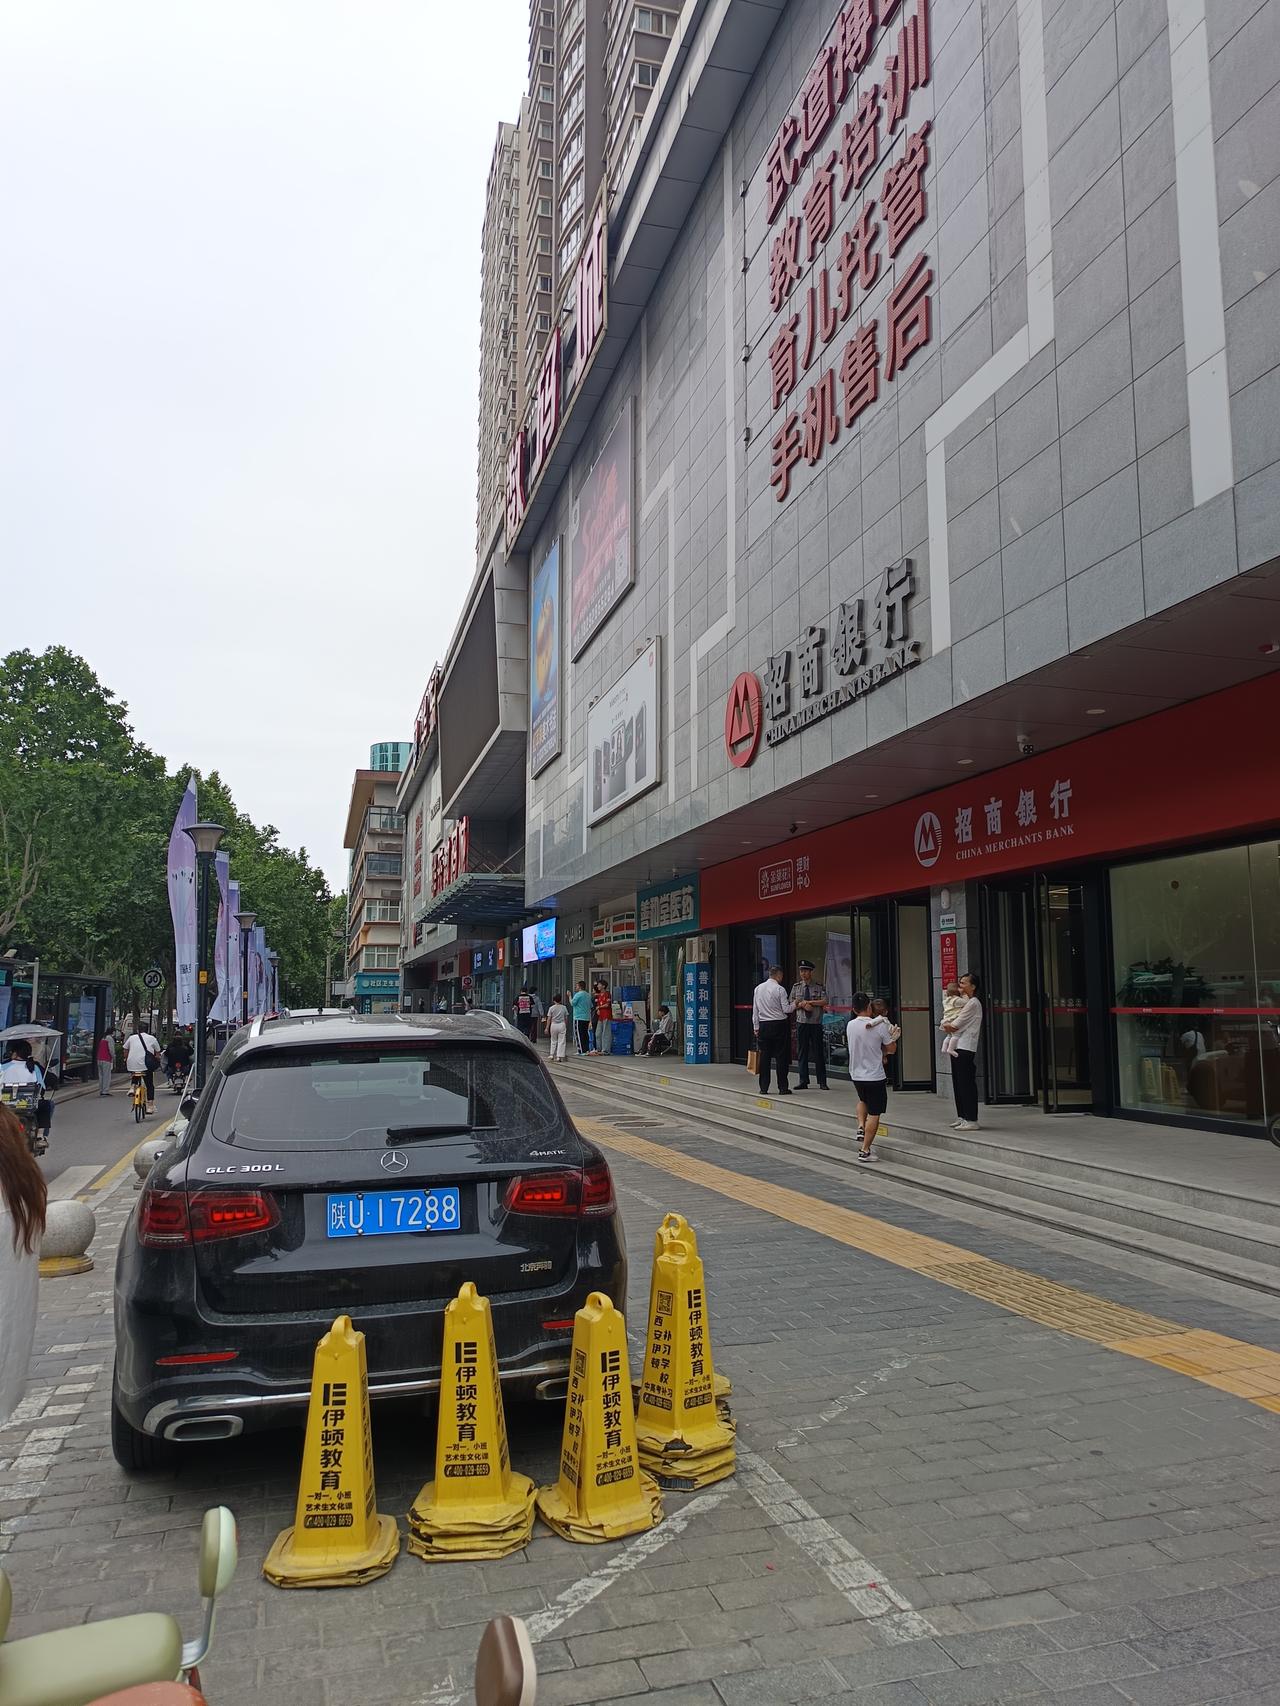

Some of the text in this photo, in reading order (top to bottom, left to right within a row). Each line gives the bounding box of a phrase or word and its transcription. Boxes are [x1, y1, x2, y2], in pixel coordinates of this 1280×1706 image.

[766, 0, 905, 225] 武道搏
[769, 0, 931, 313] 教育培训
[769, 120, 932, 411] 育儿托管
[770, 252, 933, 503] 手机售后
[764, 641, 922, 748] CHINA MERCHANTS BANK
[955, 824, 1075, 861] CHINA MERCHANTS BANK
[640, 885, 694, 931] 善和堂医药
[796, 873, 811, 890] 中心
[147, 974, 158, 983] 30
[686, 972, 694, 1056] 善和堂医药
[698, 971, 709, 1056] 善和堂医药
[205, 1163, 285, 1175] GLC 300 L
[529, 1149, 568, 1157] 4MATIC
[650, 1316, 664, 1370] 西安伊顿
[659, 1330, 673, 1385] 补习学校
[688, 1309, 704, 1377] 伊顿教育
[455, 1366, 477, 1442] 伊顿教育
[601, 1374, 622, 1449] 伊顿教育
[644, 1381, 673, 1398] 中高考补习
[319, 1409, 346, 1491] 伊顿教育
[444, 1453, 489, 1462] 艺术生文化课
[596, 1455, 633, 1471] 艺术生文化课
[305, 1502, 353, 1512] 艺术生文化课
